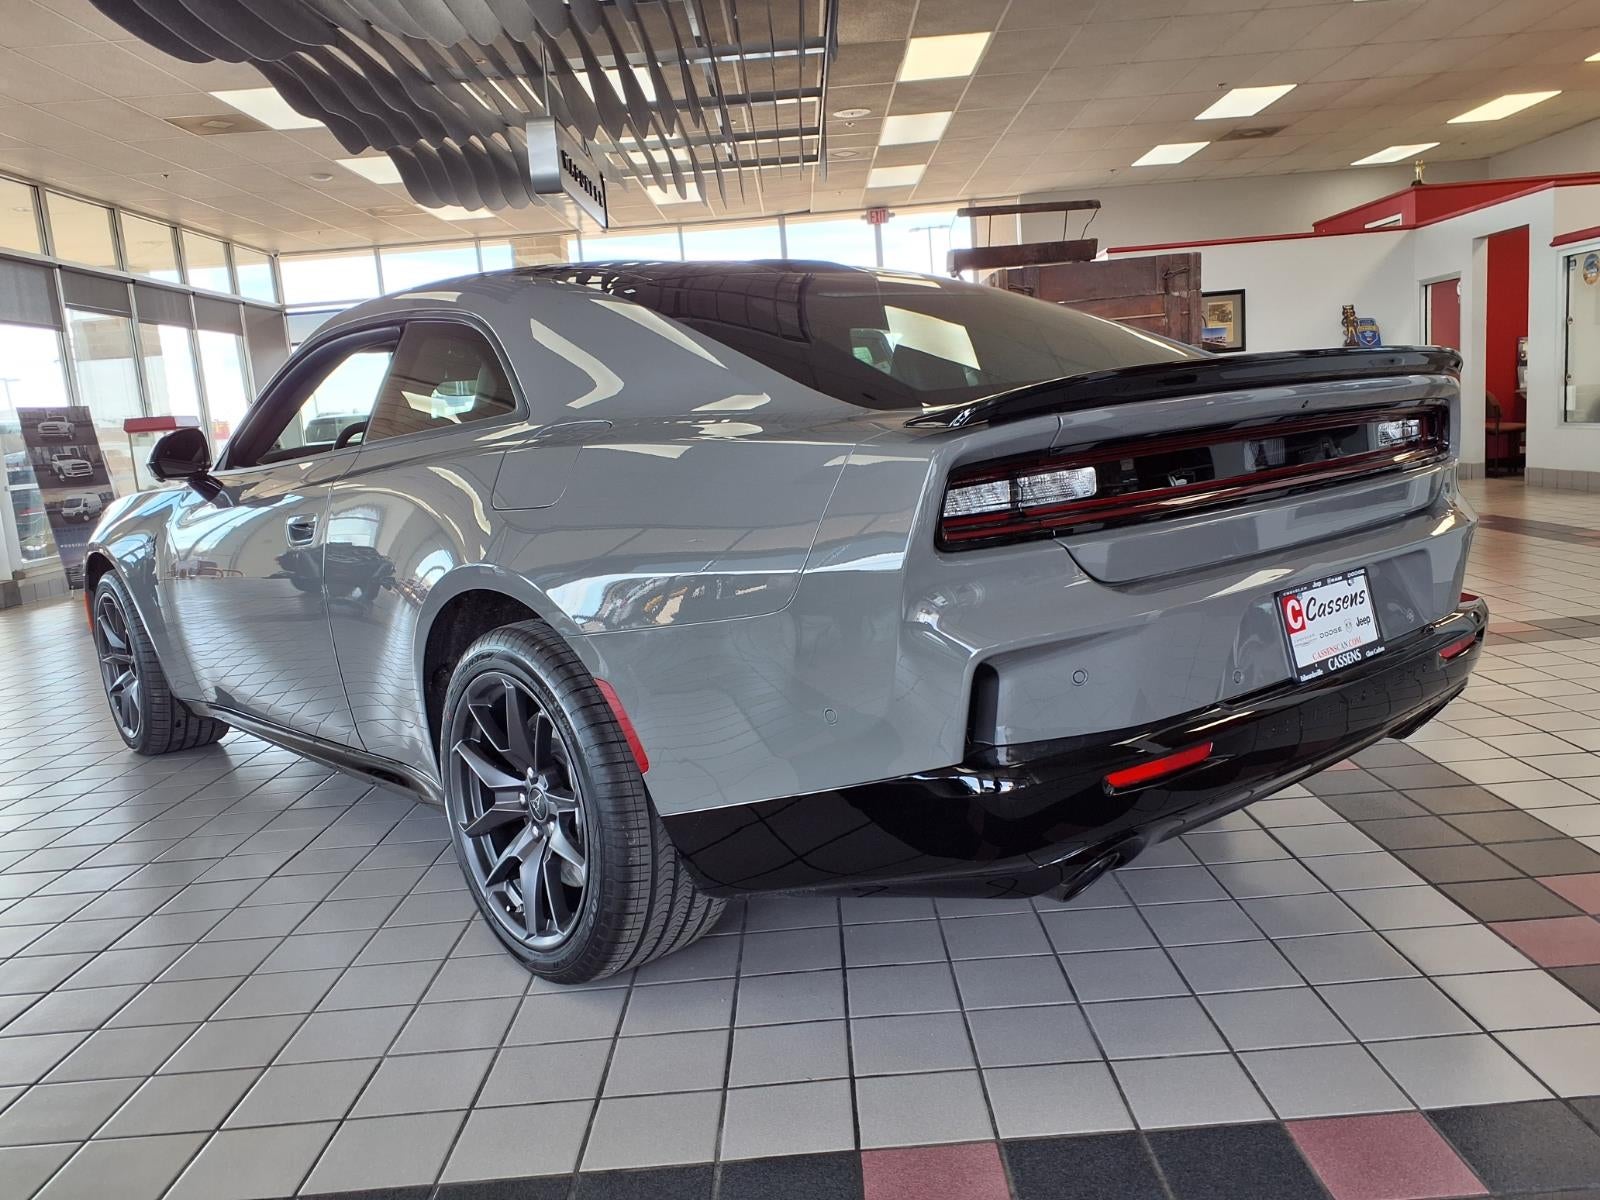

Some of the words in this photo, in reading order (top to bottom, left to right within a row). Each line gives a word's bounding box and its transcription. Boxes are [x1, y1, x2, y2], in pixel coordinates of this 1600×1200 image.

[1286, 598, 1303, 630] C
[1305, 589, 1366, 622] Cassens
[1319, 626, 1342, 639] DODGE
[1355, 615, 1371, 628] Jeep
[1327, 648, 1362, 671] CASSENS
